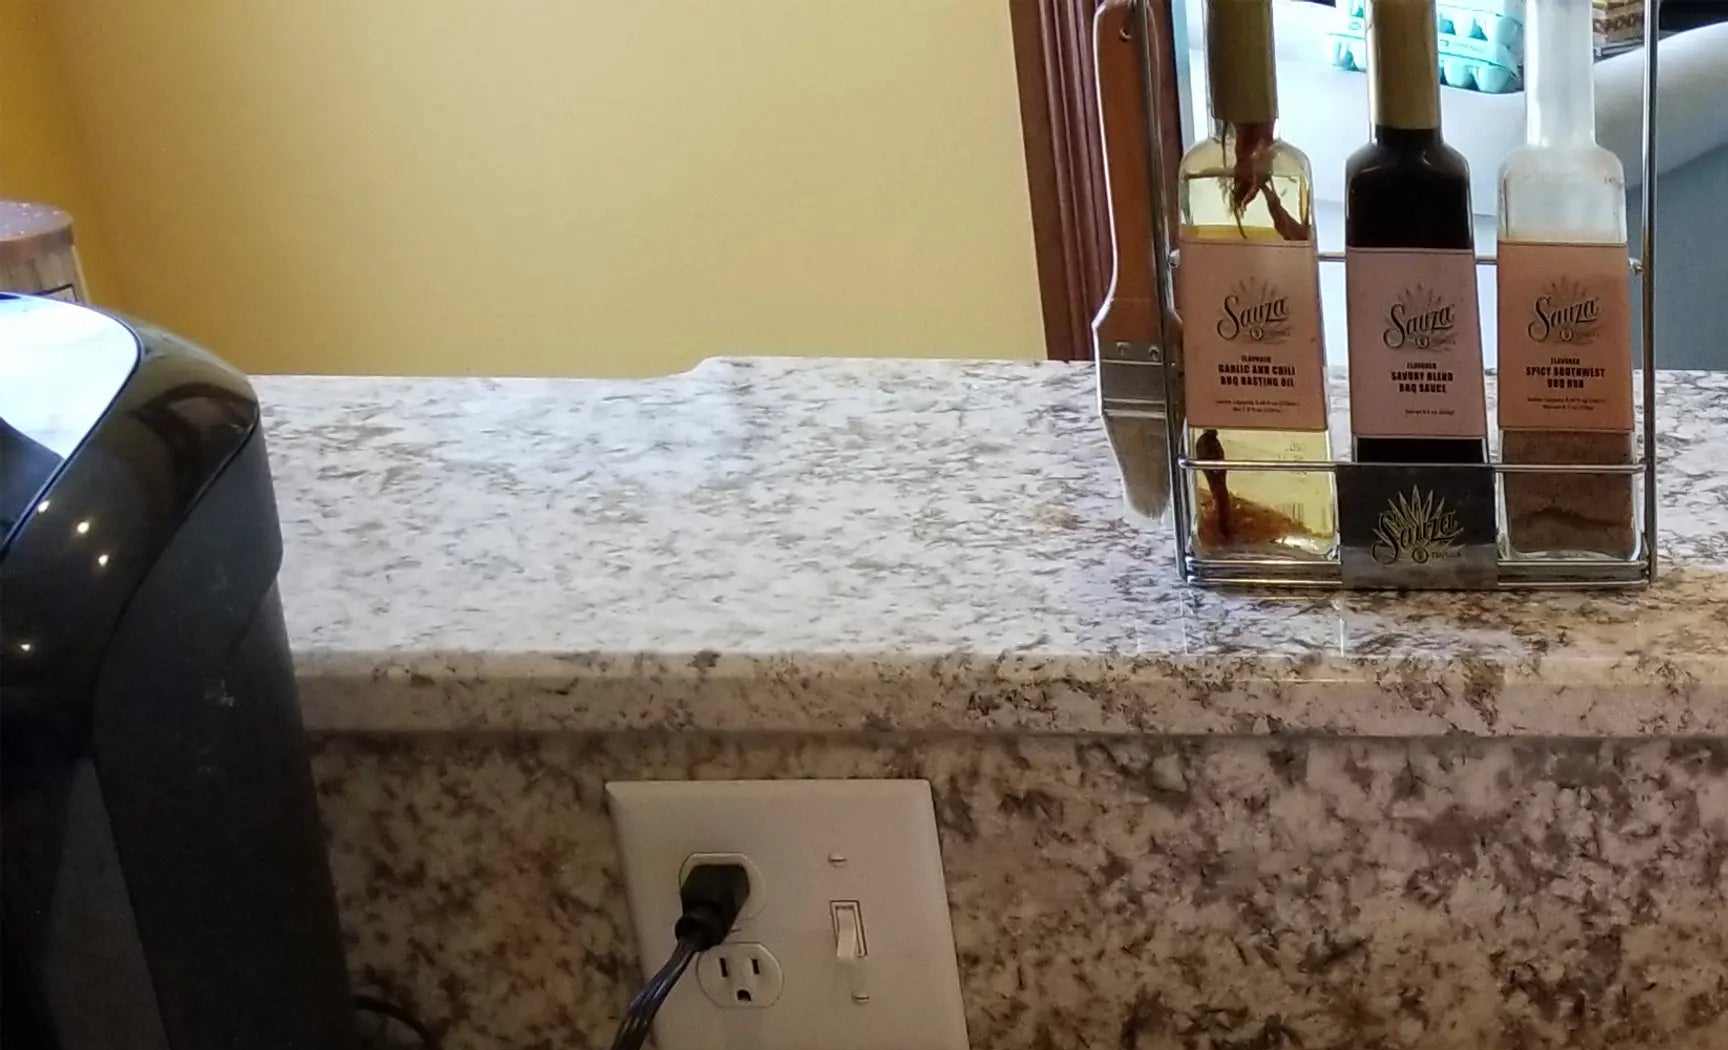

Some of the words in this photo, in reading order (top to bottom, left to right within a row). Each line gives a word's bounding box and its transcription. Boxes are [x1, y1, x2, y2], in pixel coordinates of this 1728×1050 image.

[1217, 294, 1288, 341] Sauza
[1384, 303, 1455, 348] Sauza
[1528, 296, 1599, 342] Sauza
[1218, 364, 1250, 374] GARLIC
[1252, 365, 1270, 374] AND
[1391, 371, 1424, 381] SAVORY
[1526, 366, 1551, 376] SPICY
[1553, 366, 1605, 378] SOUTHWEST
[1399, 383, 1417, 393] BBQ
[1419, 383, 1446, 393] SAUCE
[1372, 509, 1458, 566] Sauza
